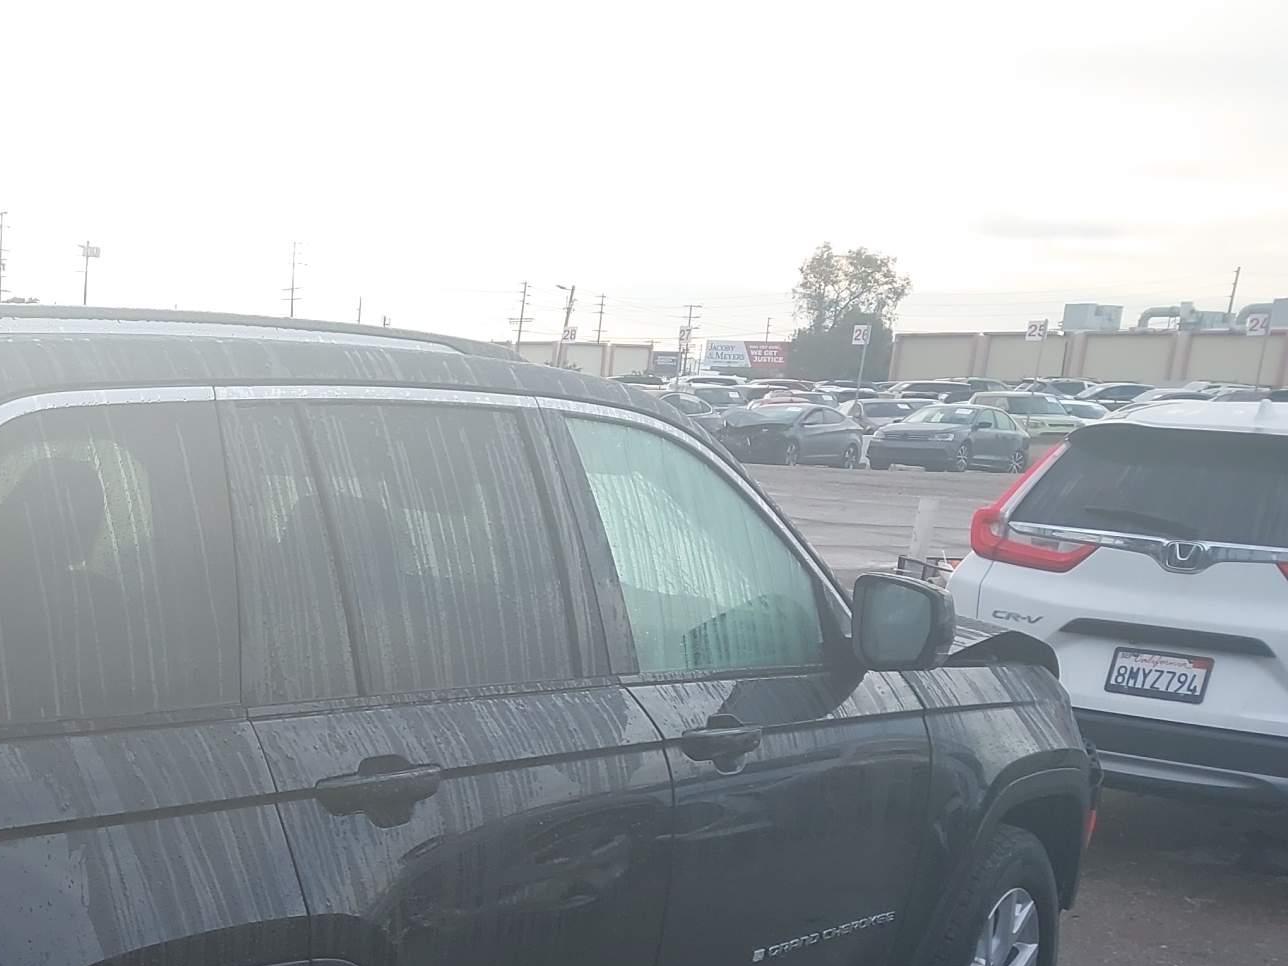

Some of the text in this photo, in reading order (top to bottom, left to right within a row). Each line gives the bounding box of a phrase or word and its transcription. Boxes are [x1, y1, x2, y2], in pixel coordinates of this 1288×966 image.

[562, 328, 577, 341] 28
[679, 329, 692, 341] 27
[855, 328, 868, 341] 26
[1028, 324, 1046, 336] 25
[992, 610, 1044, 624] CR-V
[1114, 665, 1198, 695] 8MYZ794
[768, 911, 896, 956] GRAND CHEROKEE
